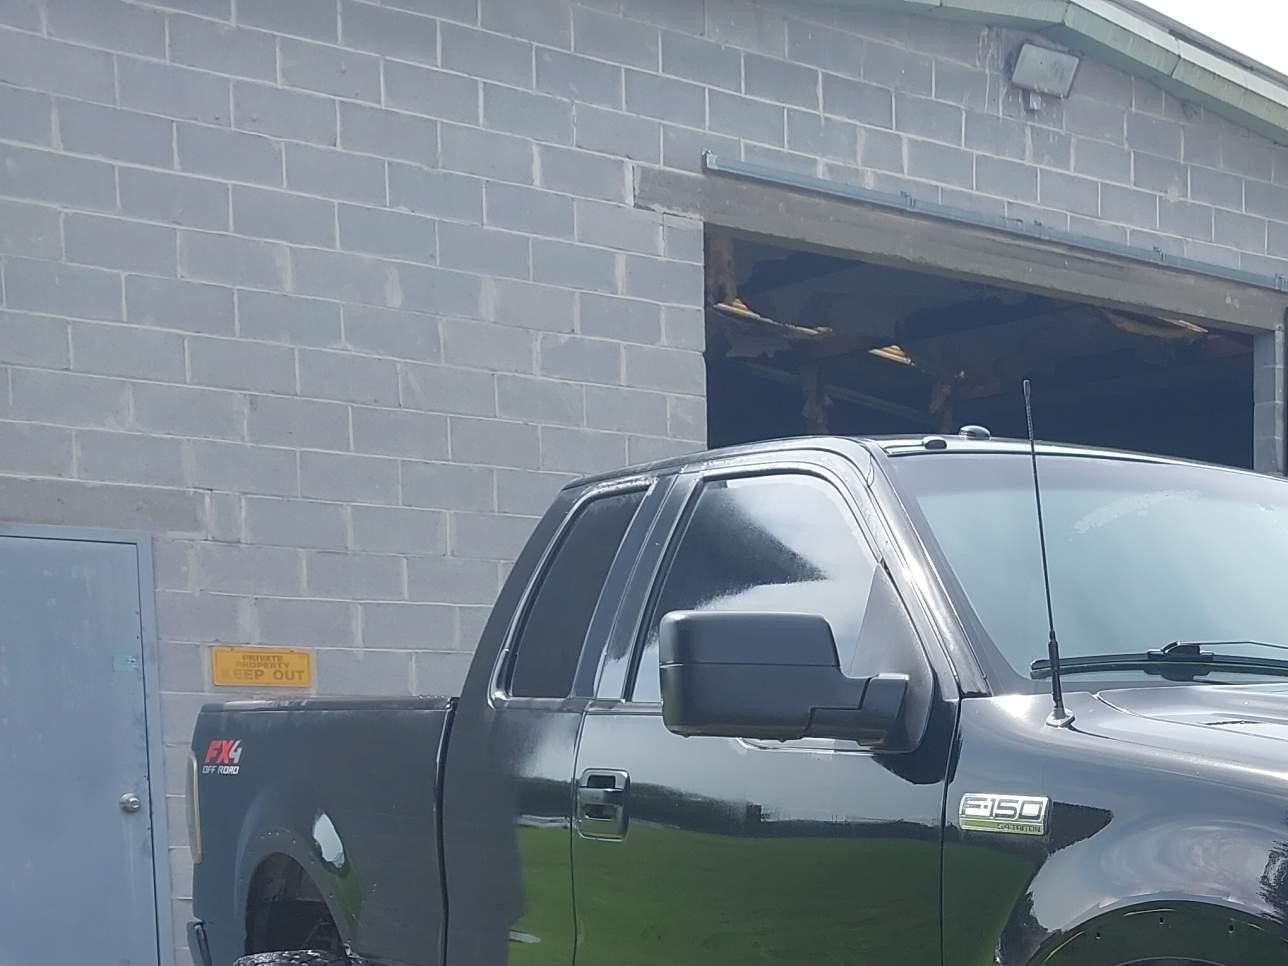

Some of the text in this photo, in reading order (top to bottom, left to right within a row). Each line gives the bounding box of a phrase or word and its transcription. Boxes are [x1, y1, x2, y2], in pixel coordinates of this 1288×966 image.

[273, 670, 304, 681] OUT
[204, 739, 242, 764] FX4
[202, 766, 240, 775] OFF ROAD
[1012, 823, 1042, 833] TRITON
